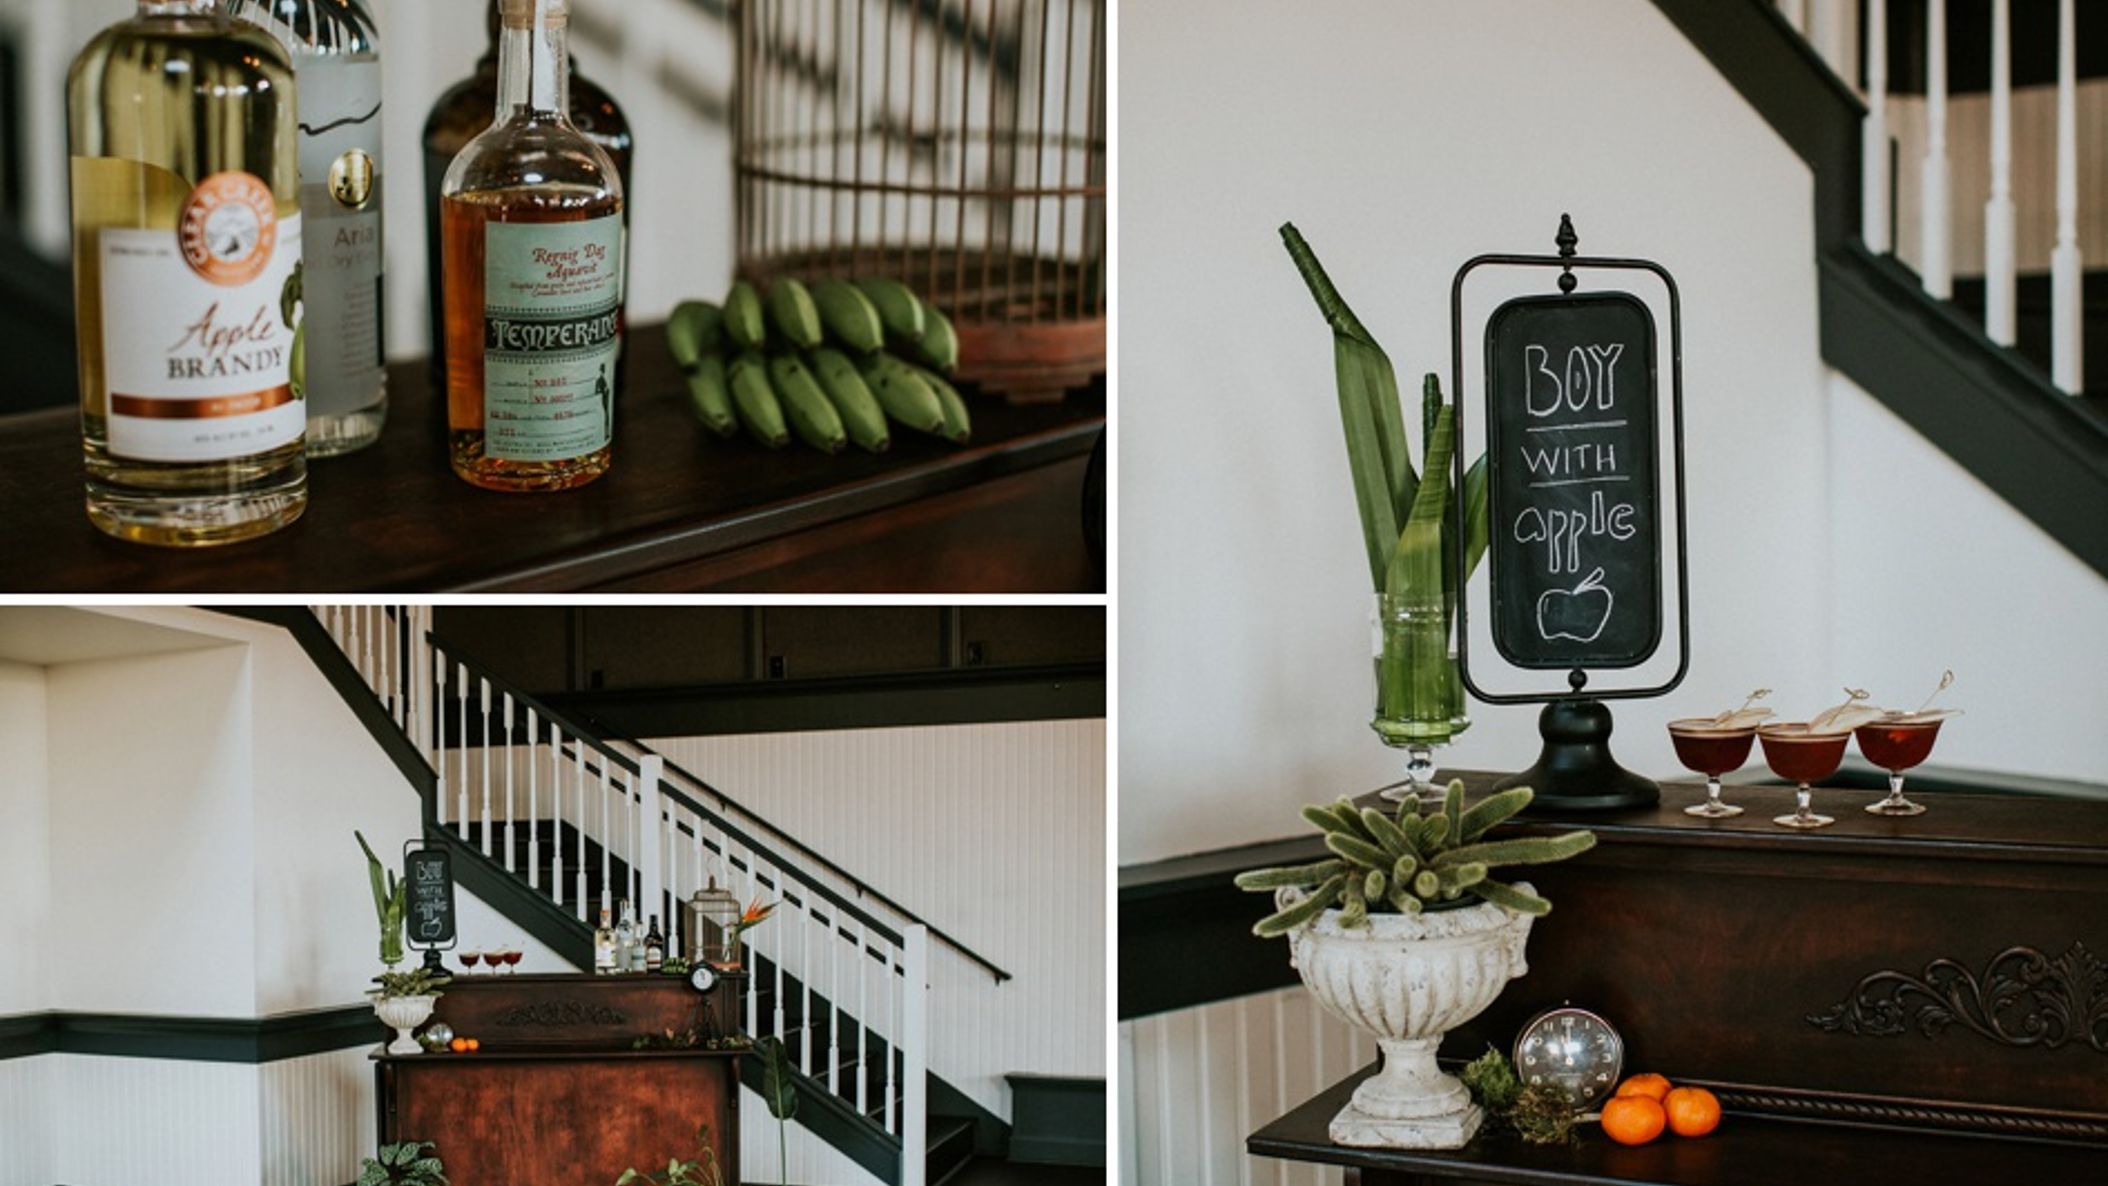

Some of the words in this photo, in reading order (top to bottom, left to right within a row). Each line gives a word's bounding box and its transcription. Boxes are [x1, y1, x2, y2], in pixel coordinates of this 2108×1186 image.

[334, 225, 375, 249] Aria
[166, 302, 276, 356] Apple
[167, 347, 283, 380] BRANDY
[1525, 343, 1625, 417] BOY
[1520, 443, 1617, 476] WITH
[1514, 490, 1636, 573] apple
